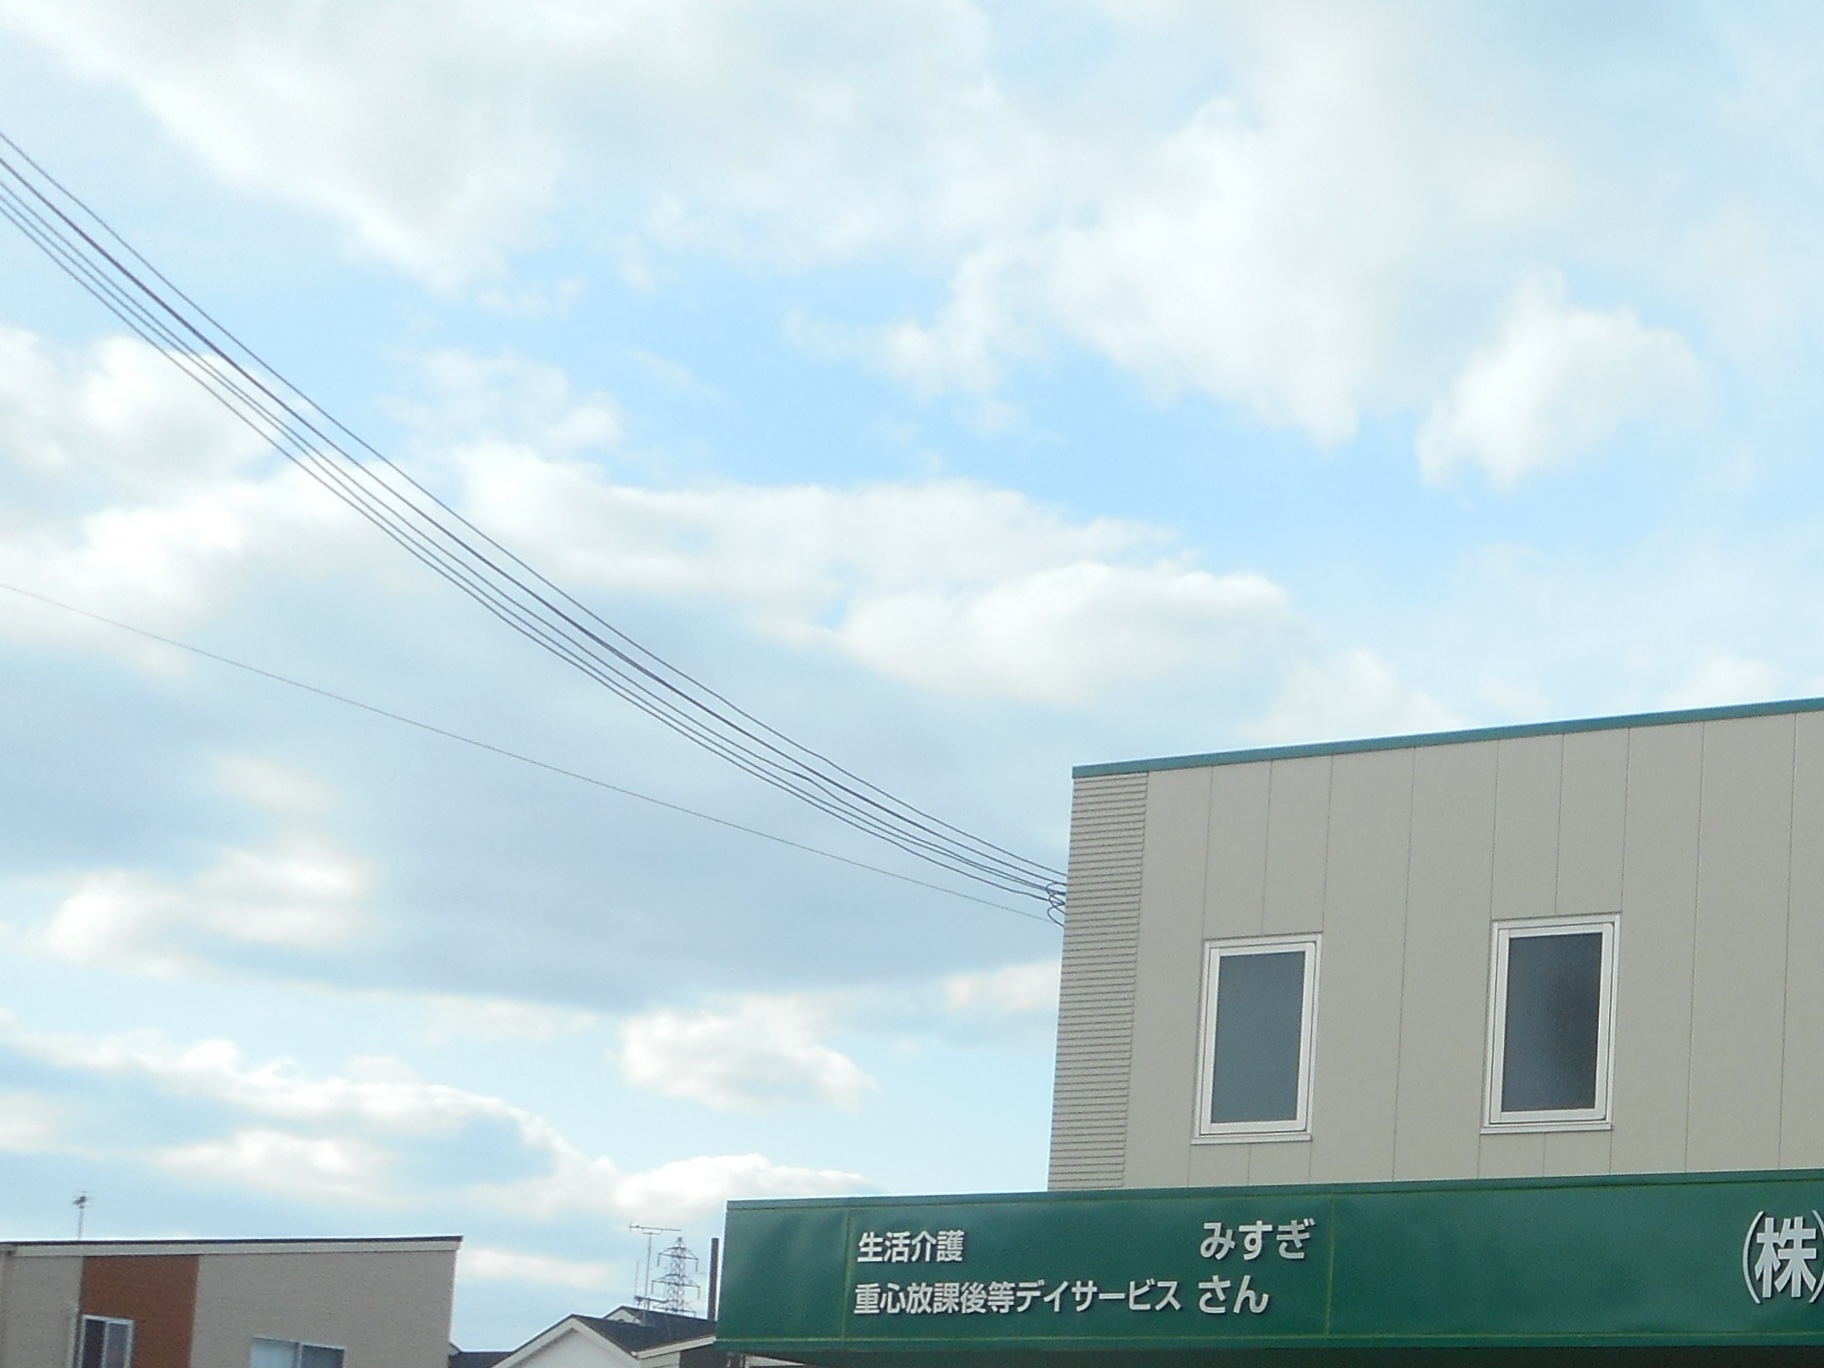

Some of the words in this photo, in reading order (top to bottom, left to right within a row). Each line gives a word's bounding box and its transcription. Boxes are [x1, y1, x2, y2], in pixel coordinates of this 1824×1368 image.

[856, 1229, 965, 1263] 生活介護
[1200, 1217, 1316, 1261] みすぎ
[853, 1278, 1182, 1315] 重心放課後等デイサービス
[1198, 1274, 1270, 1314] さん
